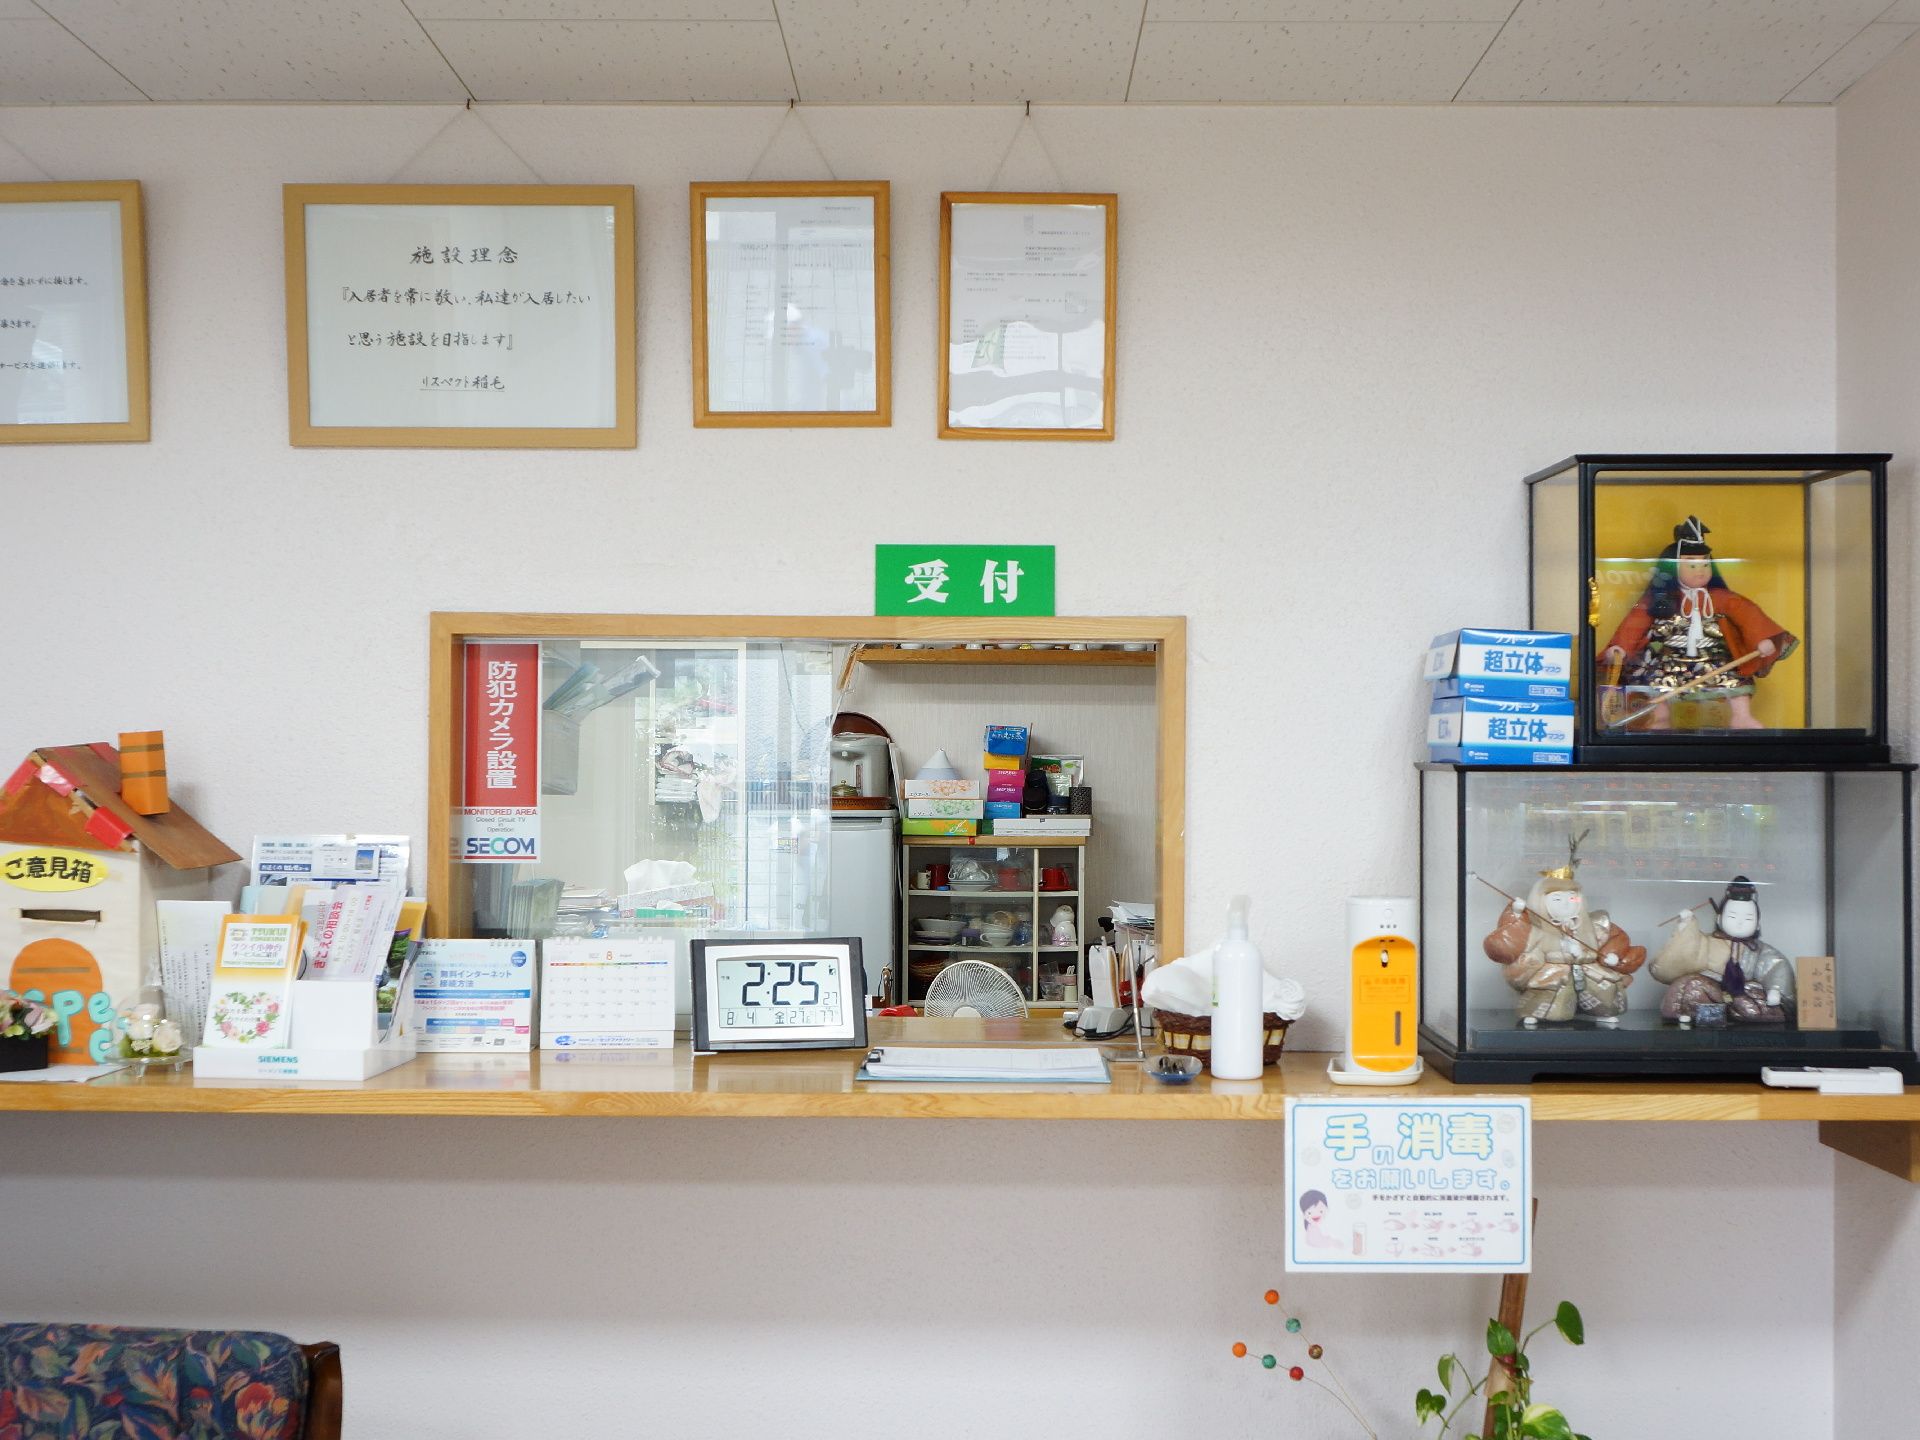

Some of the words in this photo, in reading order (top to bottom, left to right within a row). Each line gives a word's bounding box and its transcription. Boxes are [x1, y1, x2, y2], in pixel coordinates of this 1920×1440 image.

[408, 246, 519, 264] 施設理念
[347, 330, 513, 350] と思う施設を目指します』
[421, 375, 505, 390] リスペクト稲毛
[905, 559, 1025, 604] 受付
[1484, 649, 1544, 675] 超立体
[486, 660, 518, 789] 防犯カメラ設置
[1488, 717, 1548, 742] 超立体
[464, 808, 512, 816] MONITORED
[515, 808, 537, 816] AREA
[466, 837, 535, 854] SECOM
[6, 856, 93, 883] ご意見箱
[606, 951, 613, 961] 8
[441, 969, 512, 979] 無料インターネット
[440, 980, 474, 988] 接続方法
[742, 962, 819, 1006] 2:25
[823, 992, 838, 1005] 27
[727, 1011, 734, 1025] 8
[747, 1012, 755, 1024] 4
[775, 1011, 785, 1024] 金
[258, 1056, 298, 1064] SIEMENS
[1323, 1112, 1494, 1165] 手の消毒
[1331, 1168, 1511, 1190] をお願いします。
